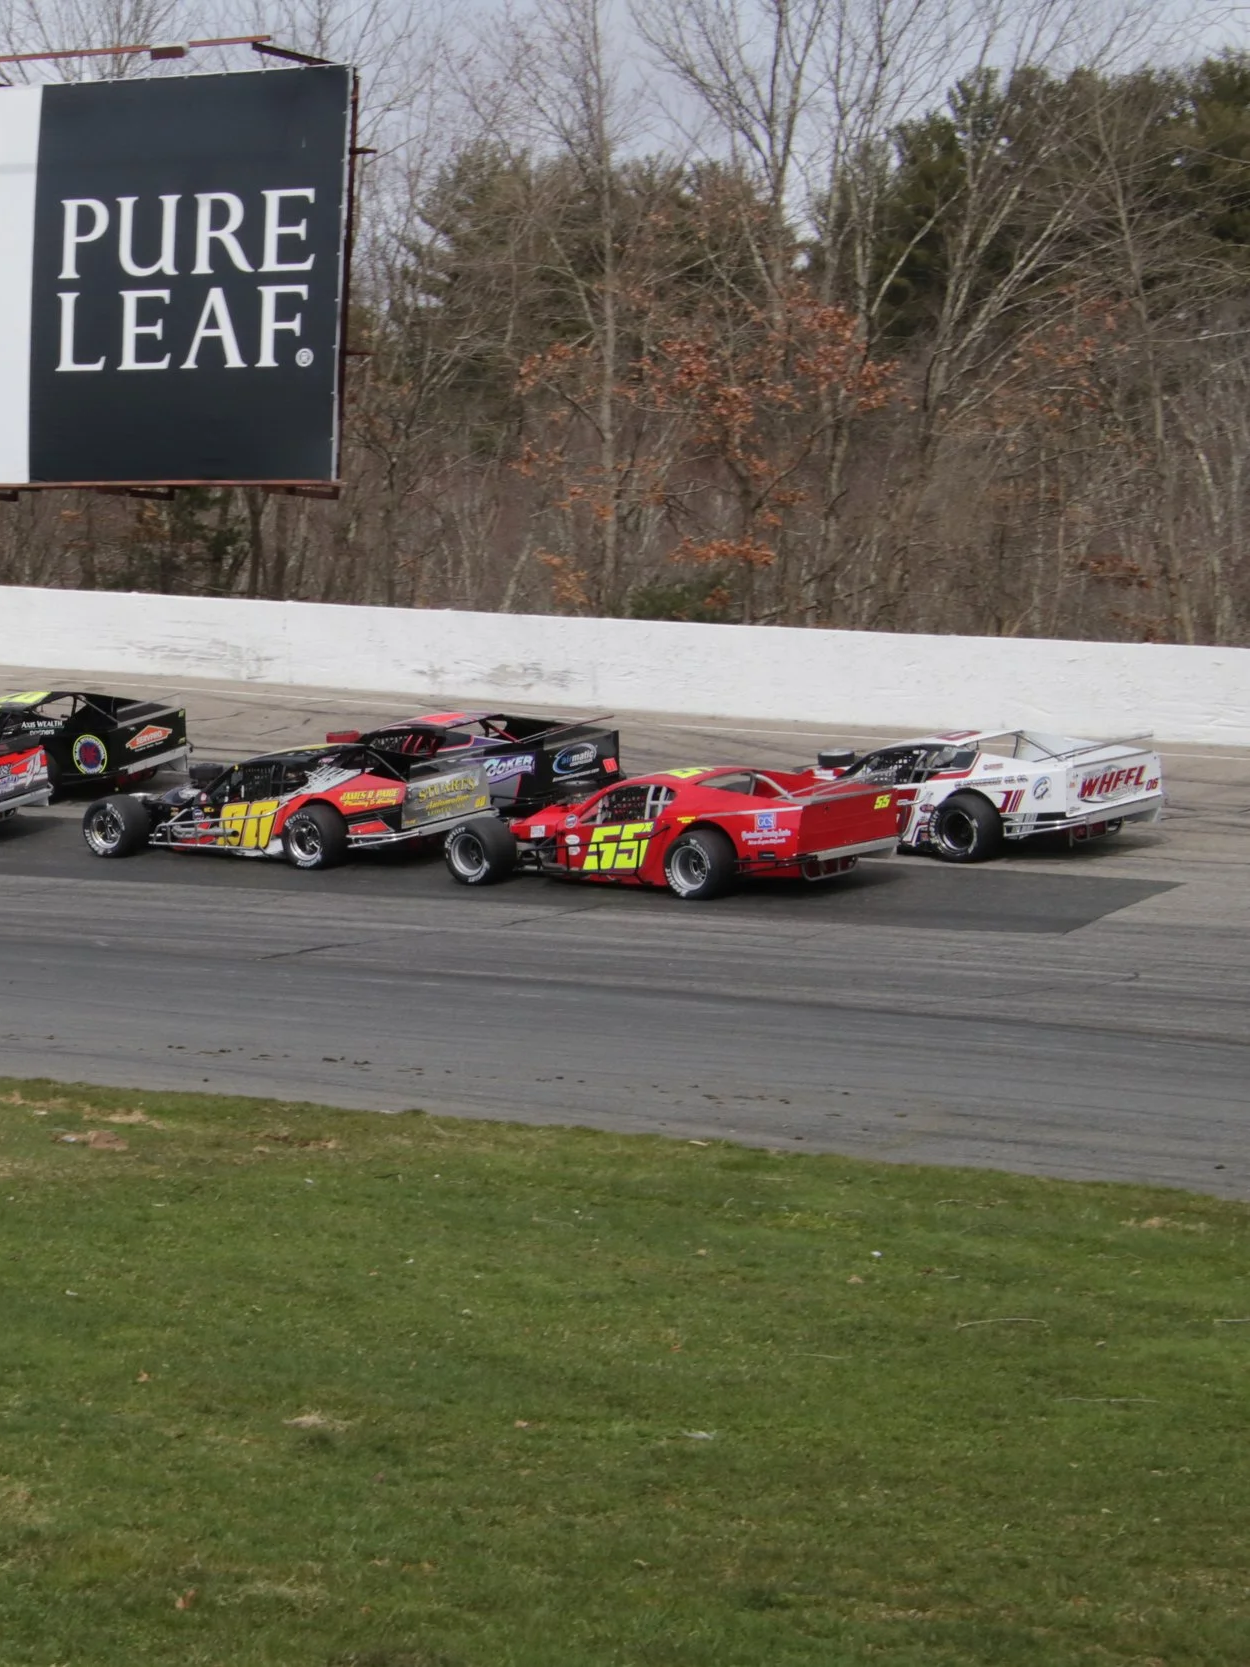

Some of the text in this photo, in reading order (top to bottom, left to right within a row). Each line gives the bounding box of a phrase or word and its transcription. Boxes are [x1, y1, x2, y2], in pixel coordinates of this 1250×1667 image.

[57, 188, 316, 279] PURE
[55, 284, 309, 372] LEAF
[37, 720, 63, 728] WEALTH
